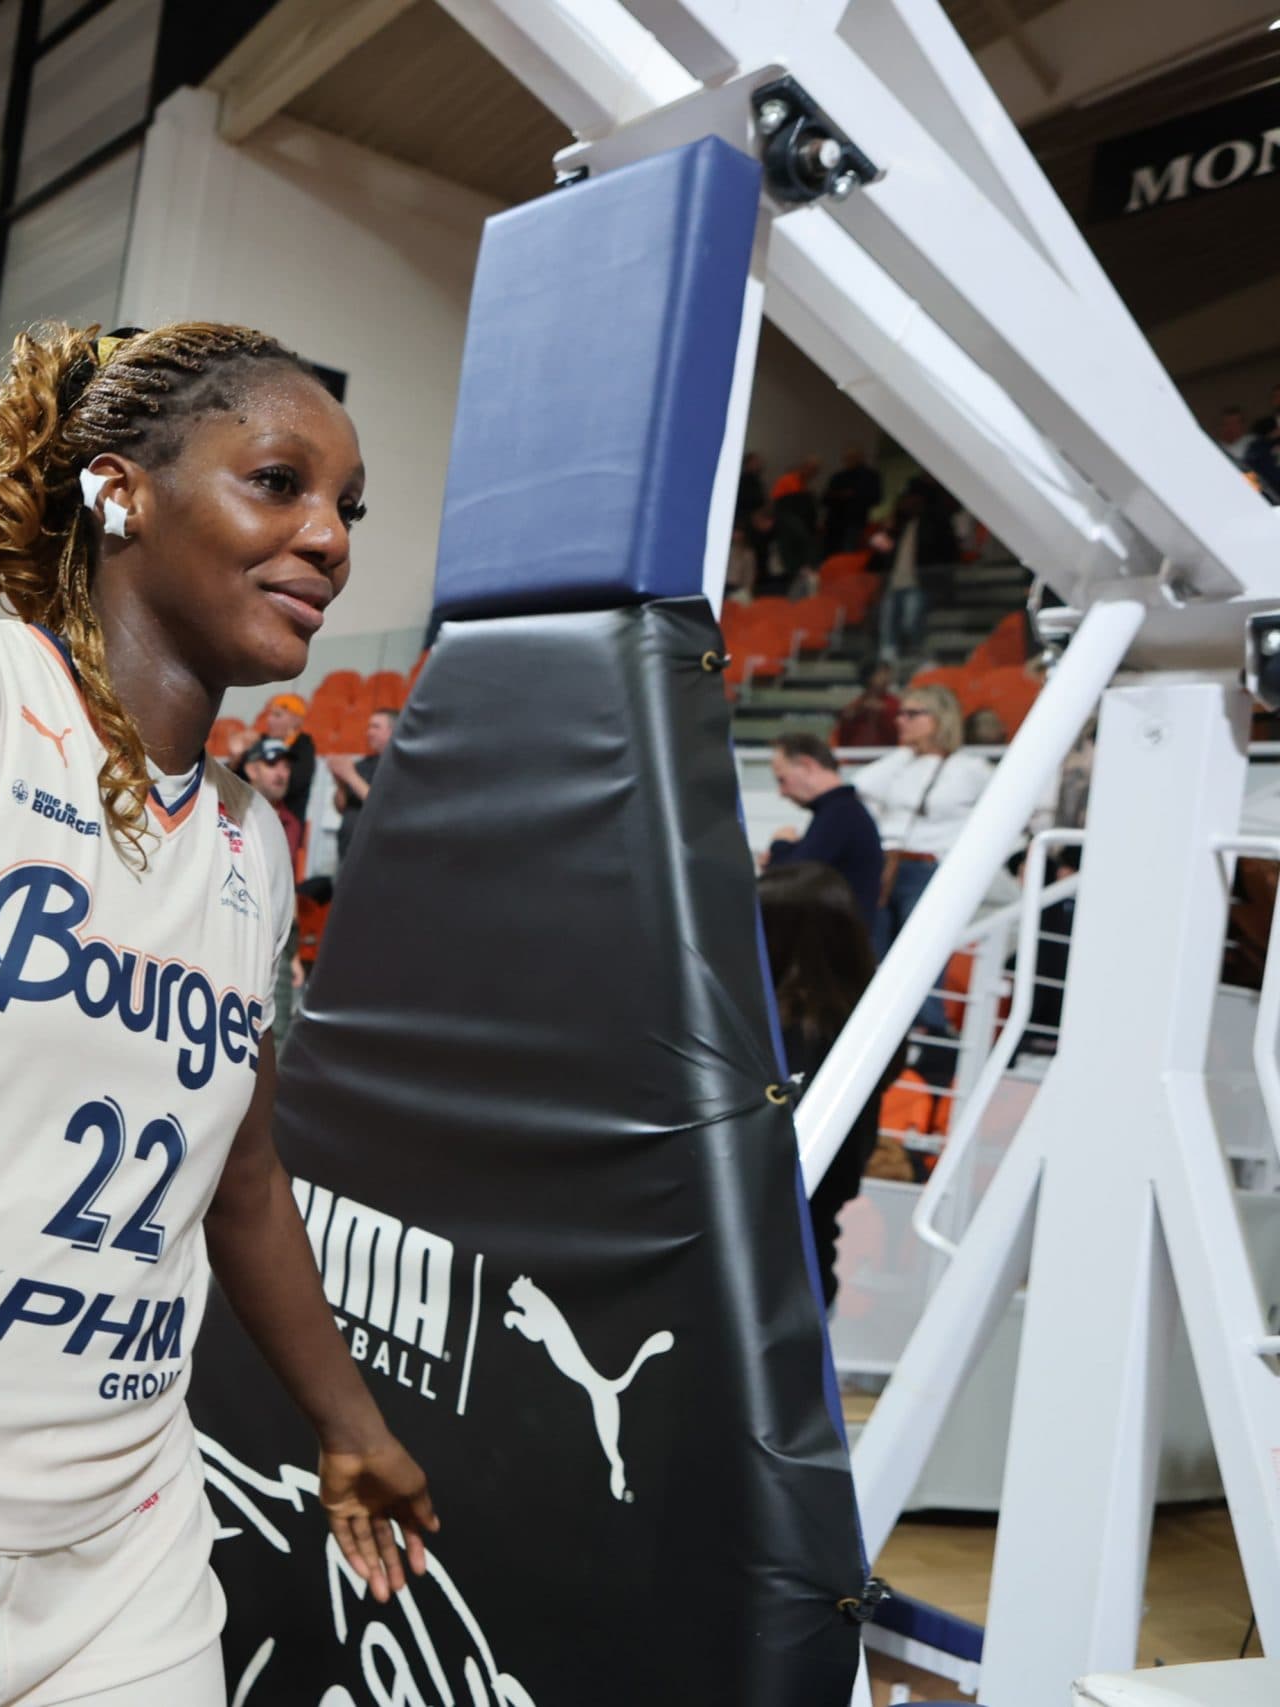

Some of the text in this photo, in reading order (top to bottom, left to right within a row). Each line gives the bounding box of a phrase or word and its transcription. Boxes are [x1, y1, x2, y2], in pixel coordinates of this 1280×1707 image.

[35, 788, 61, 807] Ville
[41, 1095, 187, 1264] 22
[292, 1175, 454, 1360] UMA
[99, 1369, 183, 1401] GROU
[334, 1315, 436, 1401] BALL
